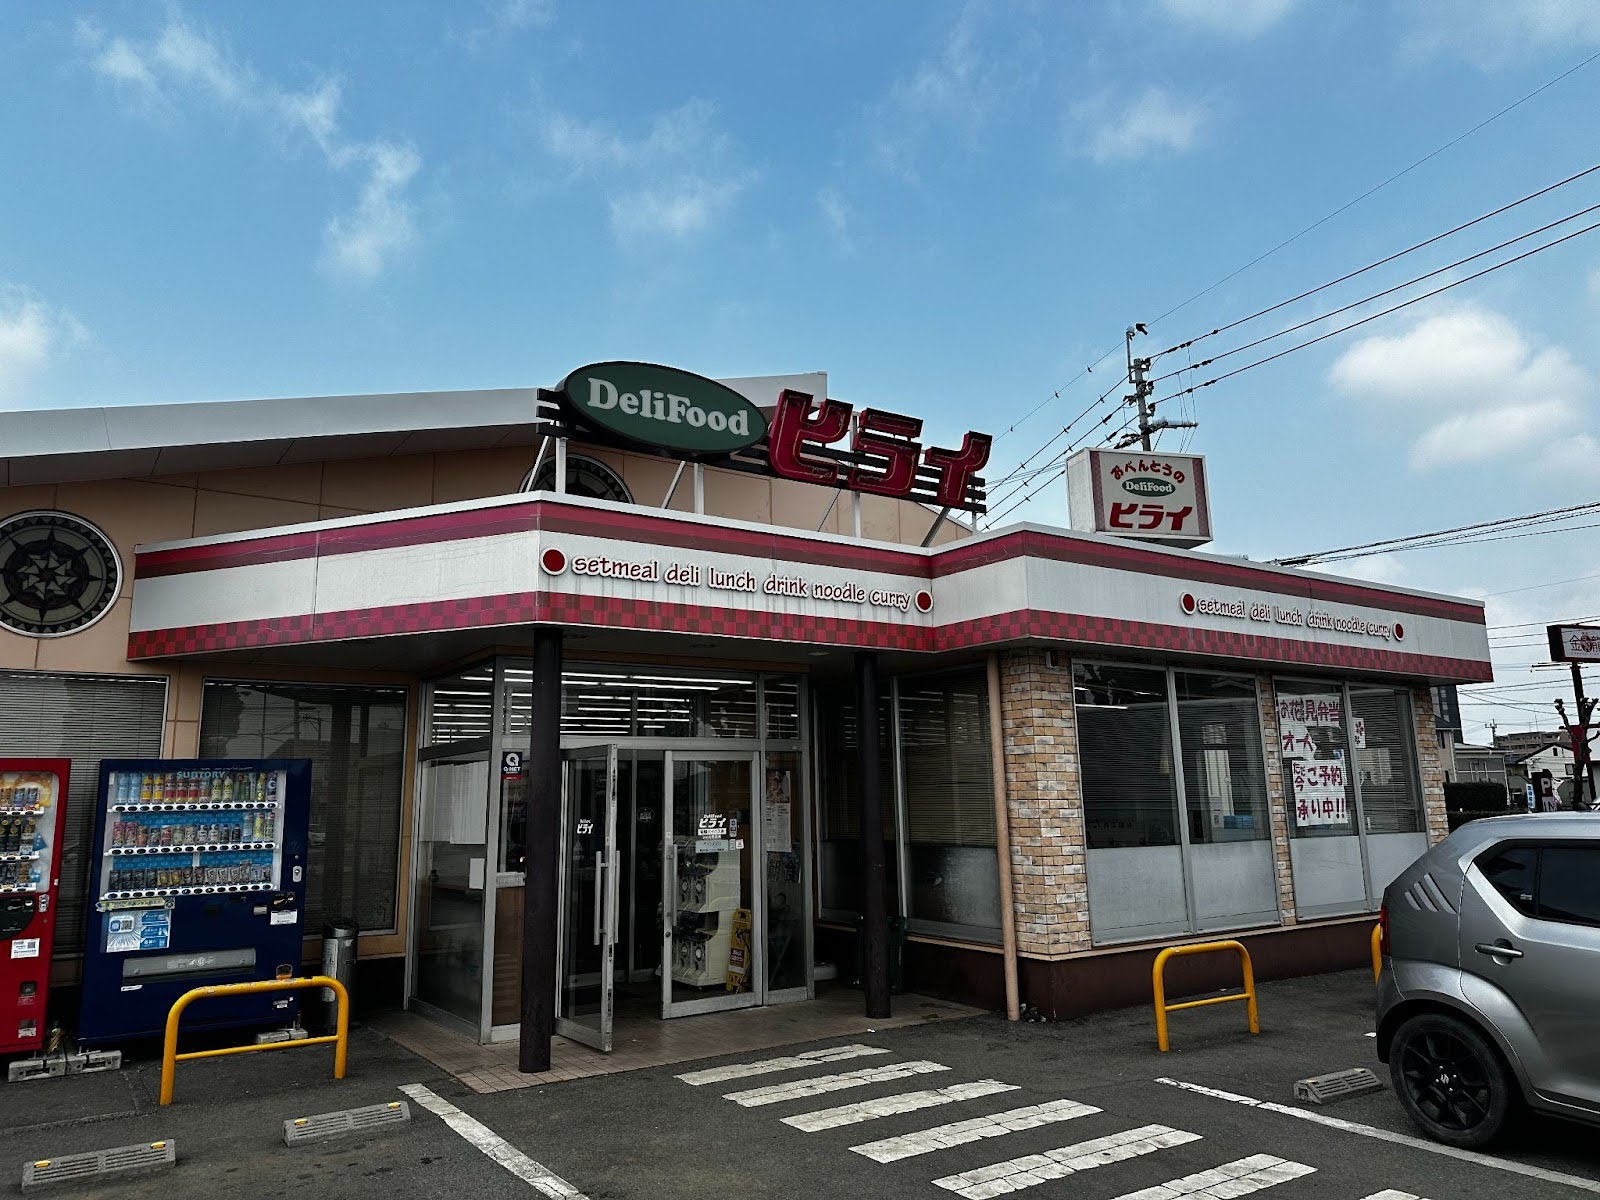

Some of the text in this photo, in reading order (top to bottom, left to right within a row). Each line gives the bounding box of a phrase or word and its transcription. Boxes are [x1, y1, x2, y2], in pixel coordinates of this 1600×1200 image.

[587, 377, 750, 436] DeliFood
[768, 388, 993, 508] ヒライ
[1110, 459, 1185, 484] おべんとうの
[1125, 481, 1173, 492] DeliFood
[1109, 502, 1193, 531] ヒライ
[574, 555, 911, 610] setmeal deli lunch drink noodle curry
[1199, 597, 1391, 641] setmeal deli lunch drink noodle curry
[1280, 698, 1339, 722] お花見弁当
[1540, 777, 1552, 794] P
[576, 823, 594, 834] ヒライ
[698, 818, 727, 828] ヒライ
